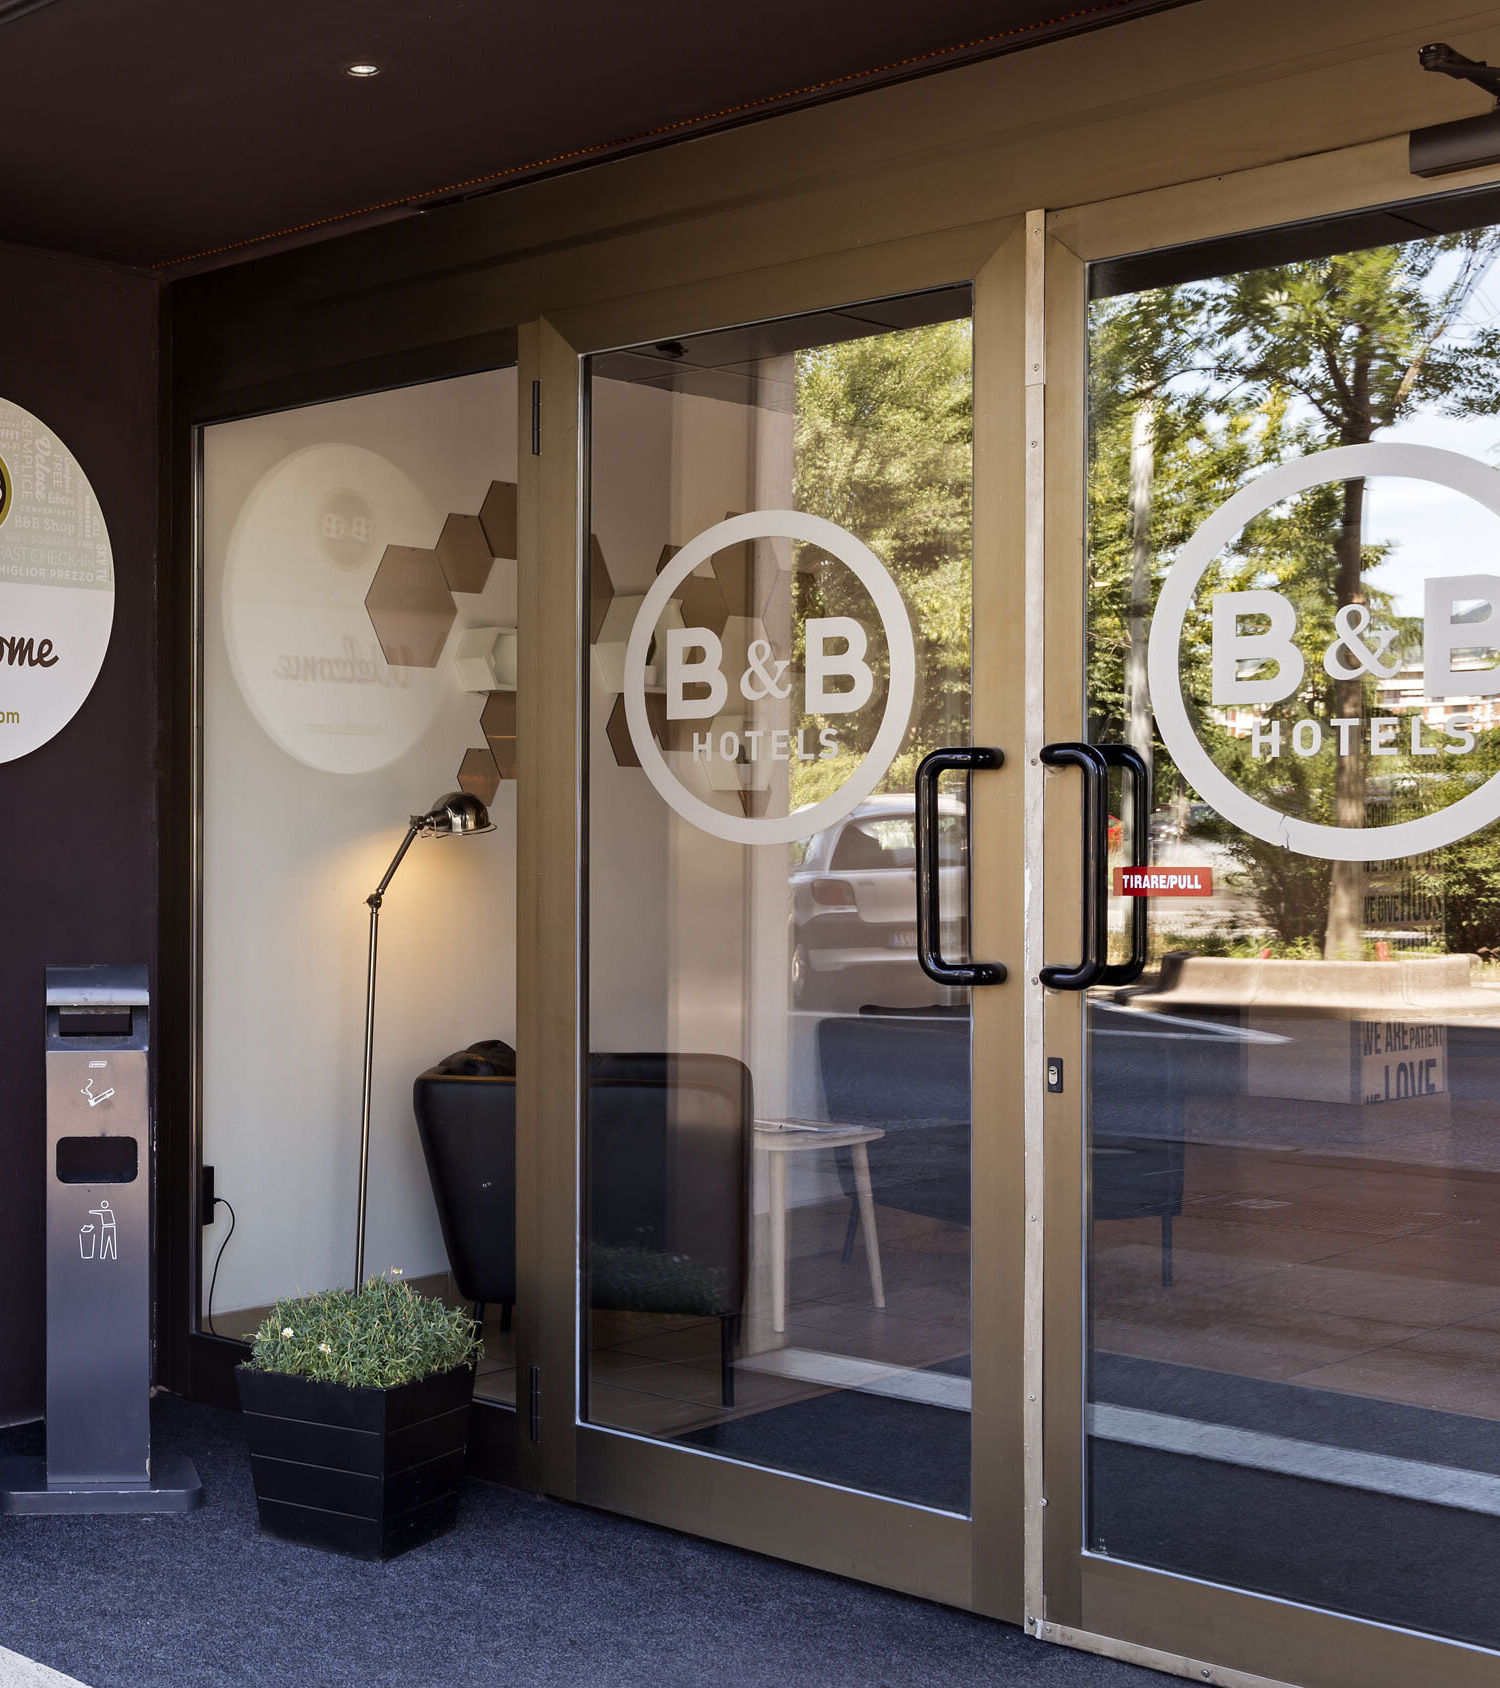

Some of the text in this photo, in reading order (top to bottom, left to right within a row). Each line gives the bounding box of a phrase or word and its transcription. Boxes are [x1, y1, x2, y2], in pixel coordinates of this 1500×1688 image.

[22, 419, 33, 500] SEMPLICE
[52, 454, 63, 489] FREE
[14, 516, 76, 536] B&B Shop
[49, 570, 94, 582] PREZZO
[1212, 574, 1500, 706] B&B
[667, 616, 874, 721] B&B
[693, 727, 839, 762] HOTELS
[1251, 715, 1476, 758] HOTELS
[1122, 874, 1202, 889] TIRARE/PULL
[1363, 1021, 1444, 1056] WE ARE PATIENT
